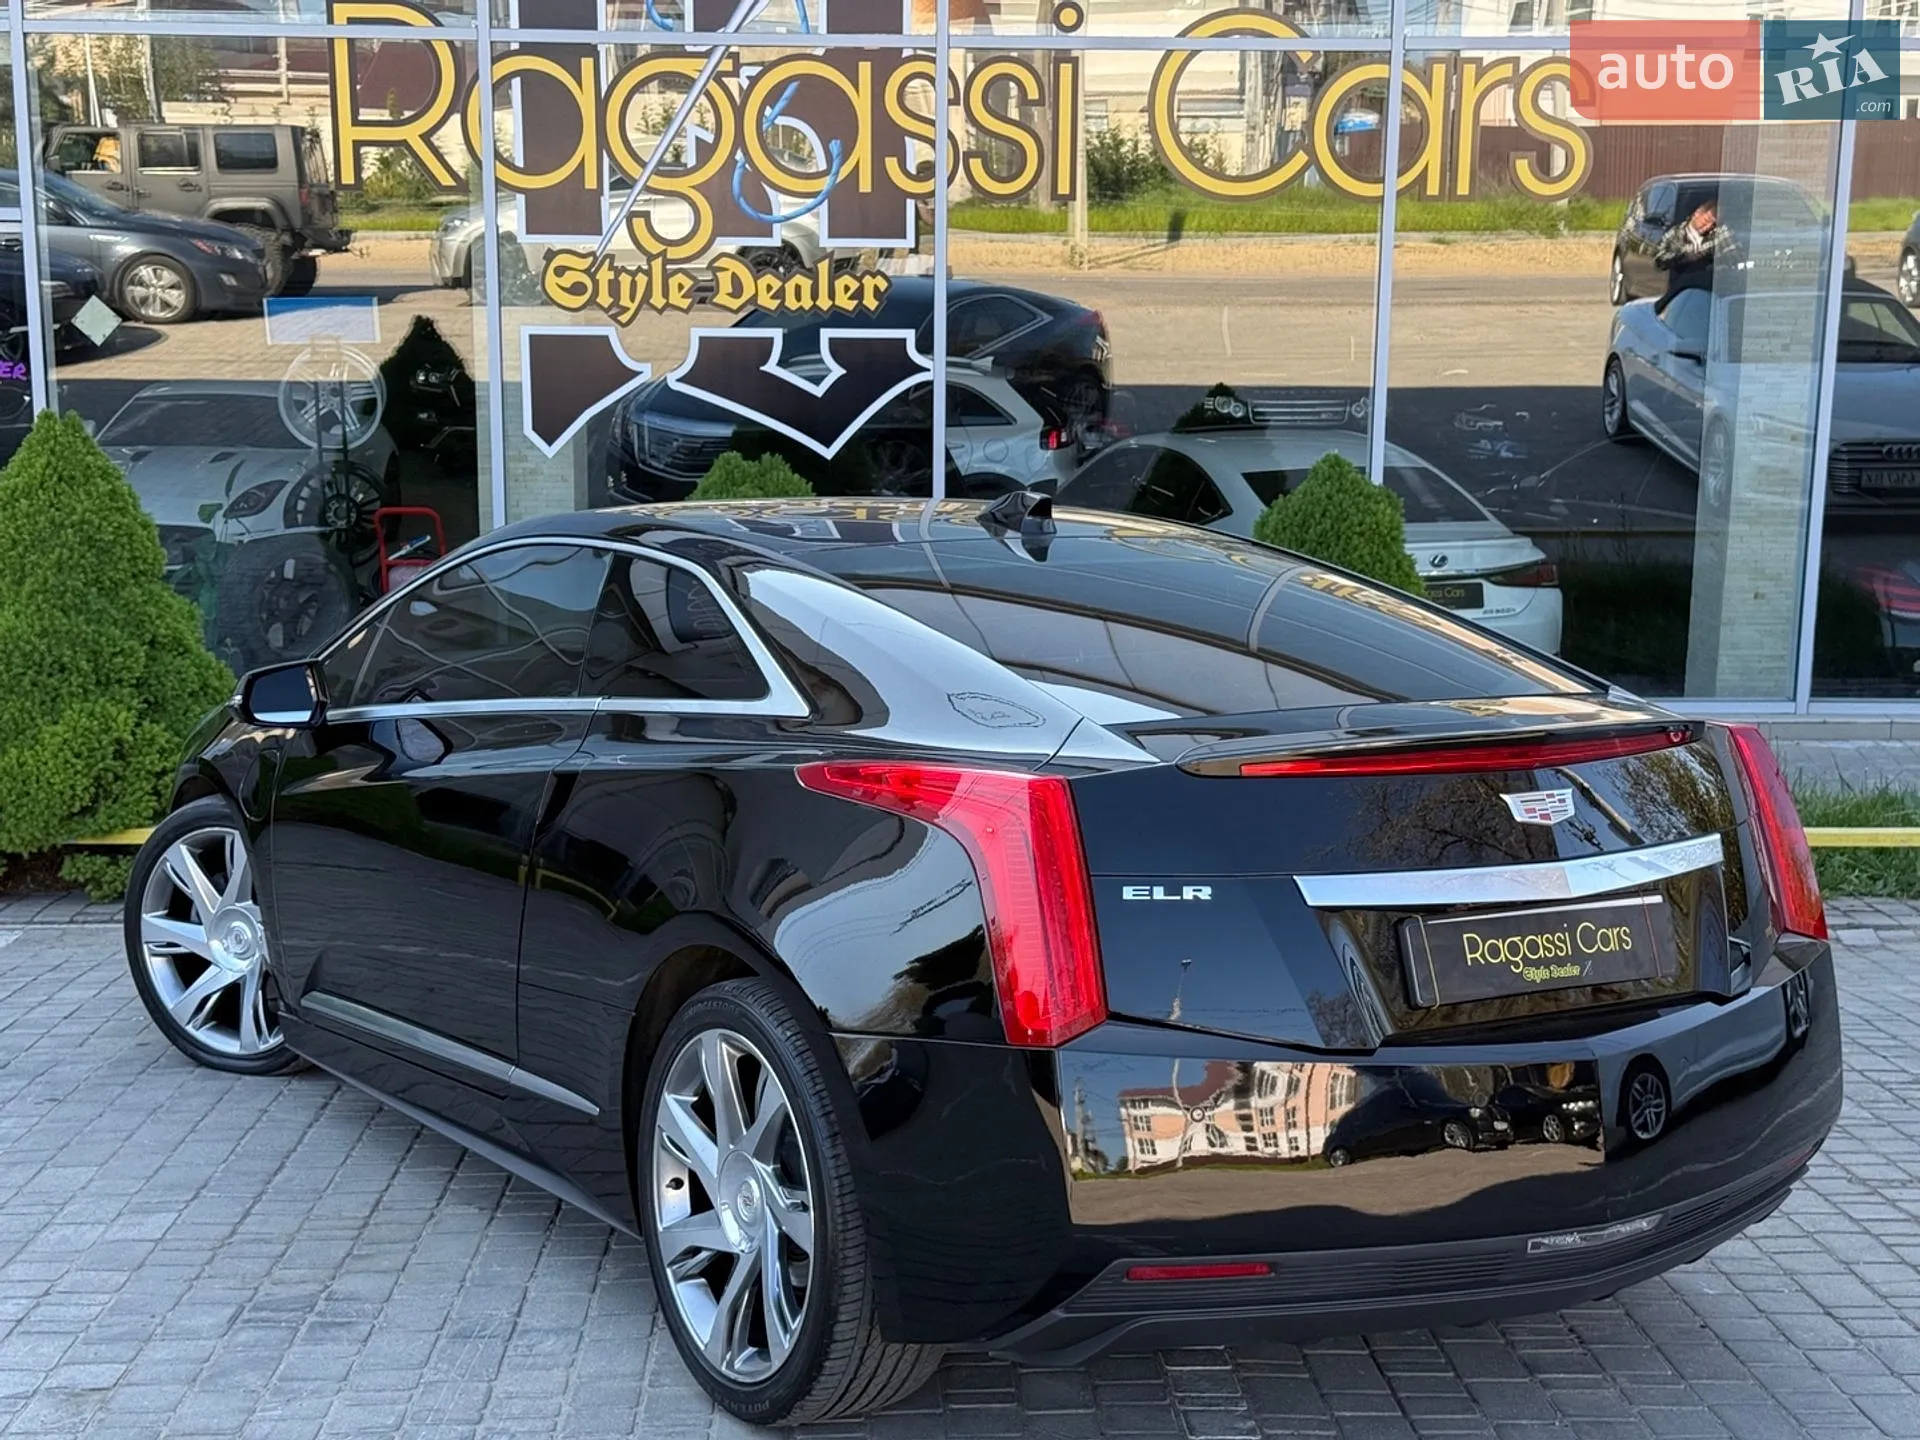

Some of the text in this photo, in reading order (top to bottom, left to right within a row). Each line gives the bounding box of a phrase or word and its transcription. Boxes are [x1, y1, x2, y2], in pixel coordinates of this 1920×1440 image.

[328, 1, 1596, 260] Ragassi Cars
[541, 245, 892, 325] Style Dealer
[1122, 885, 1212, 900] ELR
[1462, 921, 1633, 973] Ragassi Cars
[1550, 963, 1581, 980] Dealer
